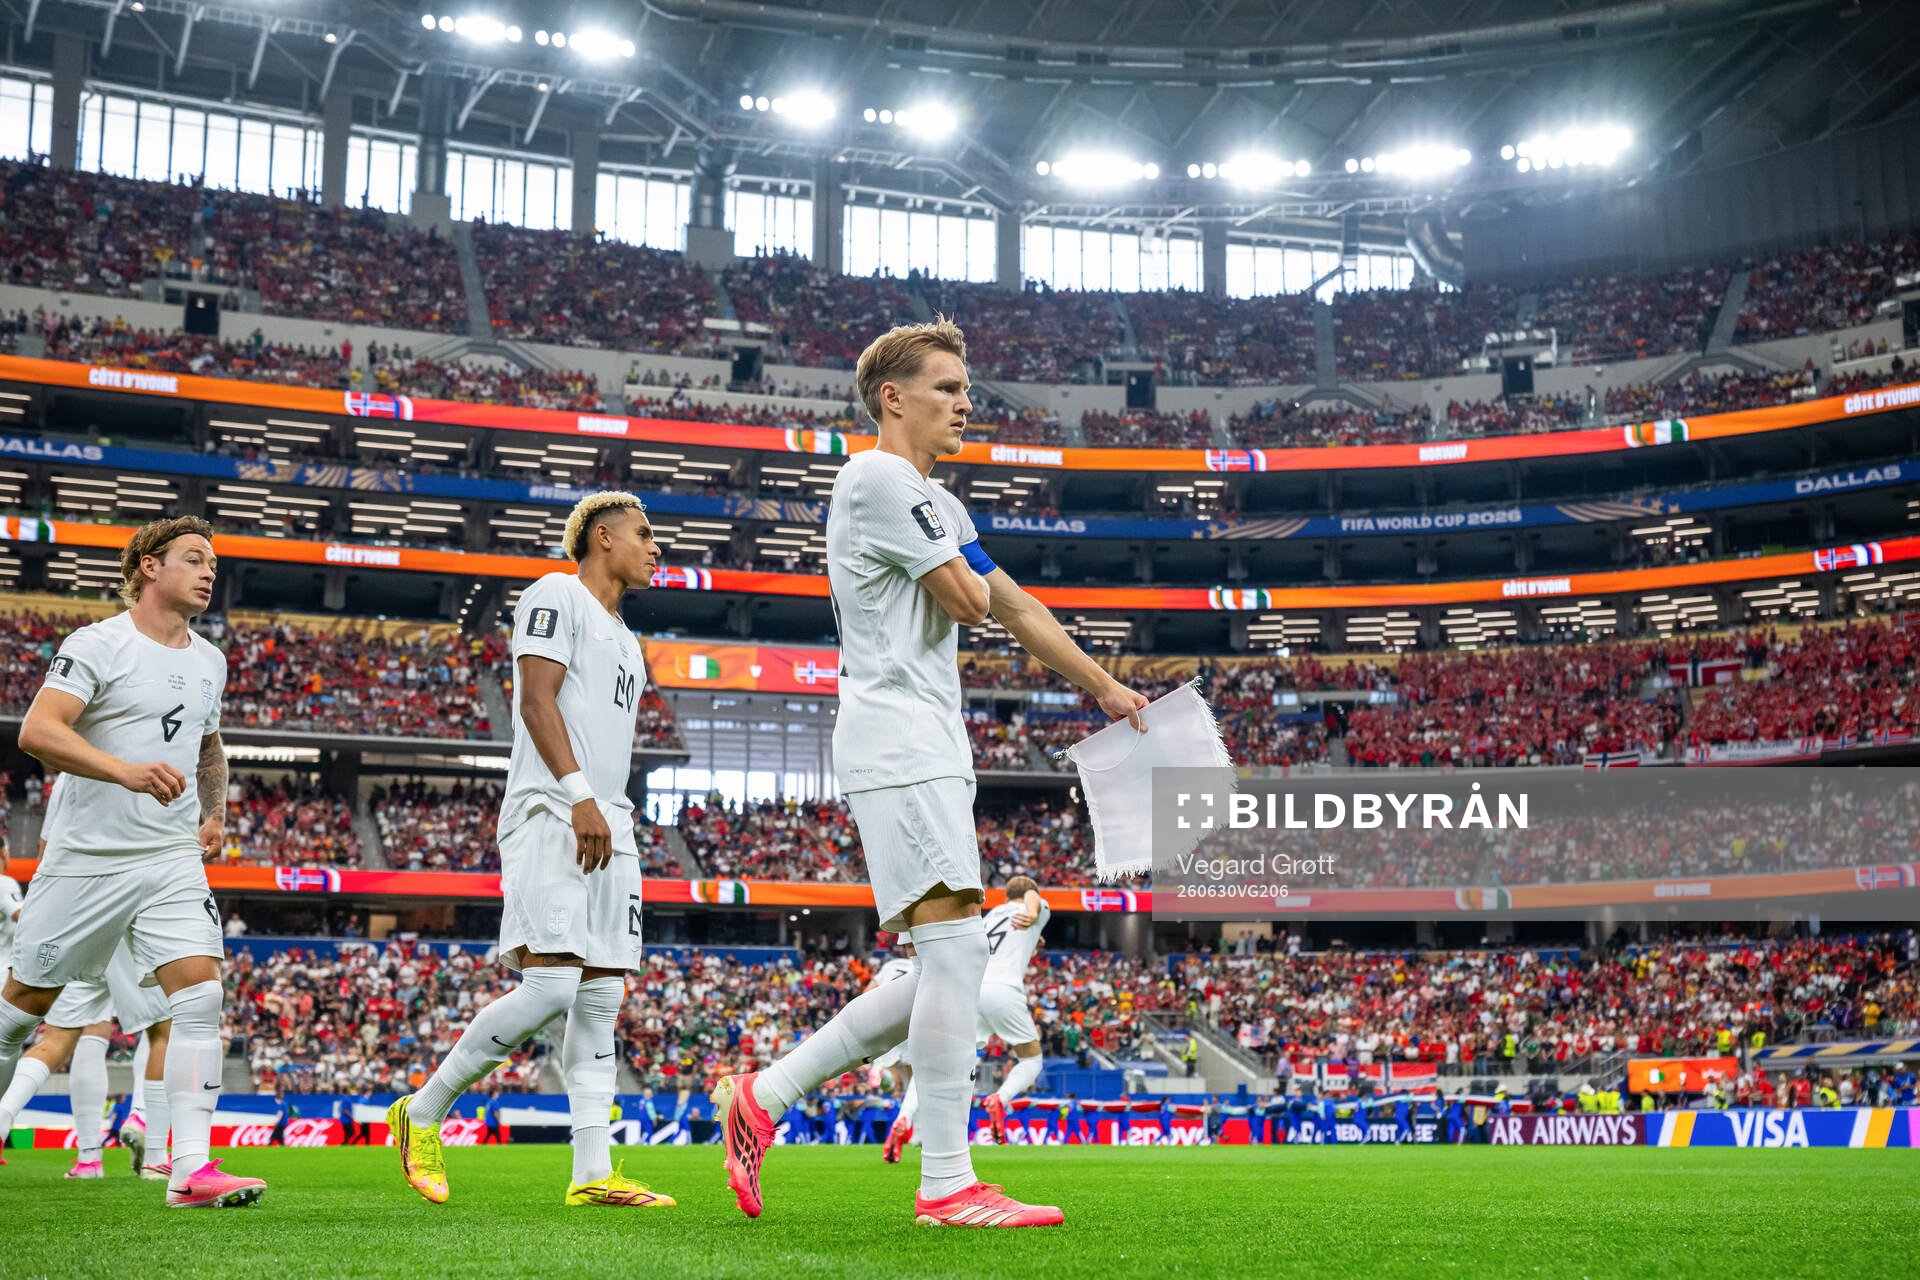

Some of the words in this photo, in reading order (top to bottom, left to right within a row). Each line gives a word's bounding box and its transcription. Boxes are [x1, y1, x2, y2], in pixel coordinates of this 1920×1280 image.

[89, 367, 122, 387] CÔTE
[1844, 394, 1875, 414] CÔTE
[1875, 386, 1920, 408] D'IVOIR
[1795, 465, 1901, 494] DALLAS
[992, 516, 1086, 533] DALLAS
[1342, 518, 1375, 531] FIFA
[1377, 515, 1432, 530] WORLD
[1434, 514, 1466, 528] CUP
[1467, 509, 1522, 525] 2026
[614, 664, 634, 713] 20
[161, 703, 185, 743] 6
[1532, 1115, 1636, 1146] AIRWAYS
[1724, 1111, 1809, 1147] VISA
